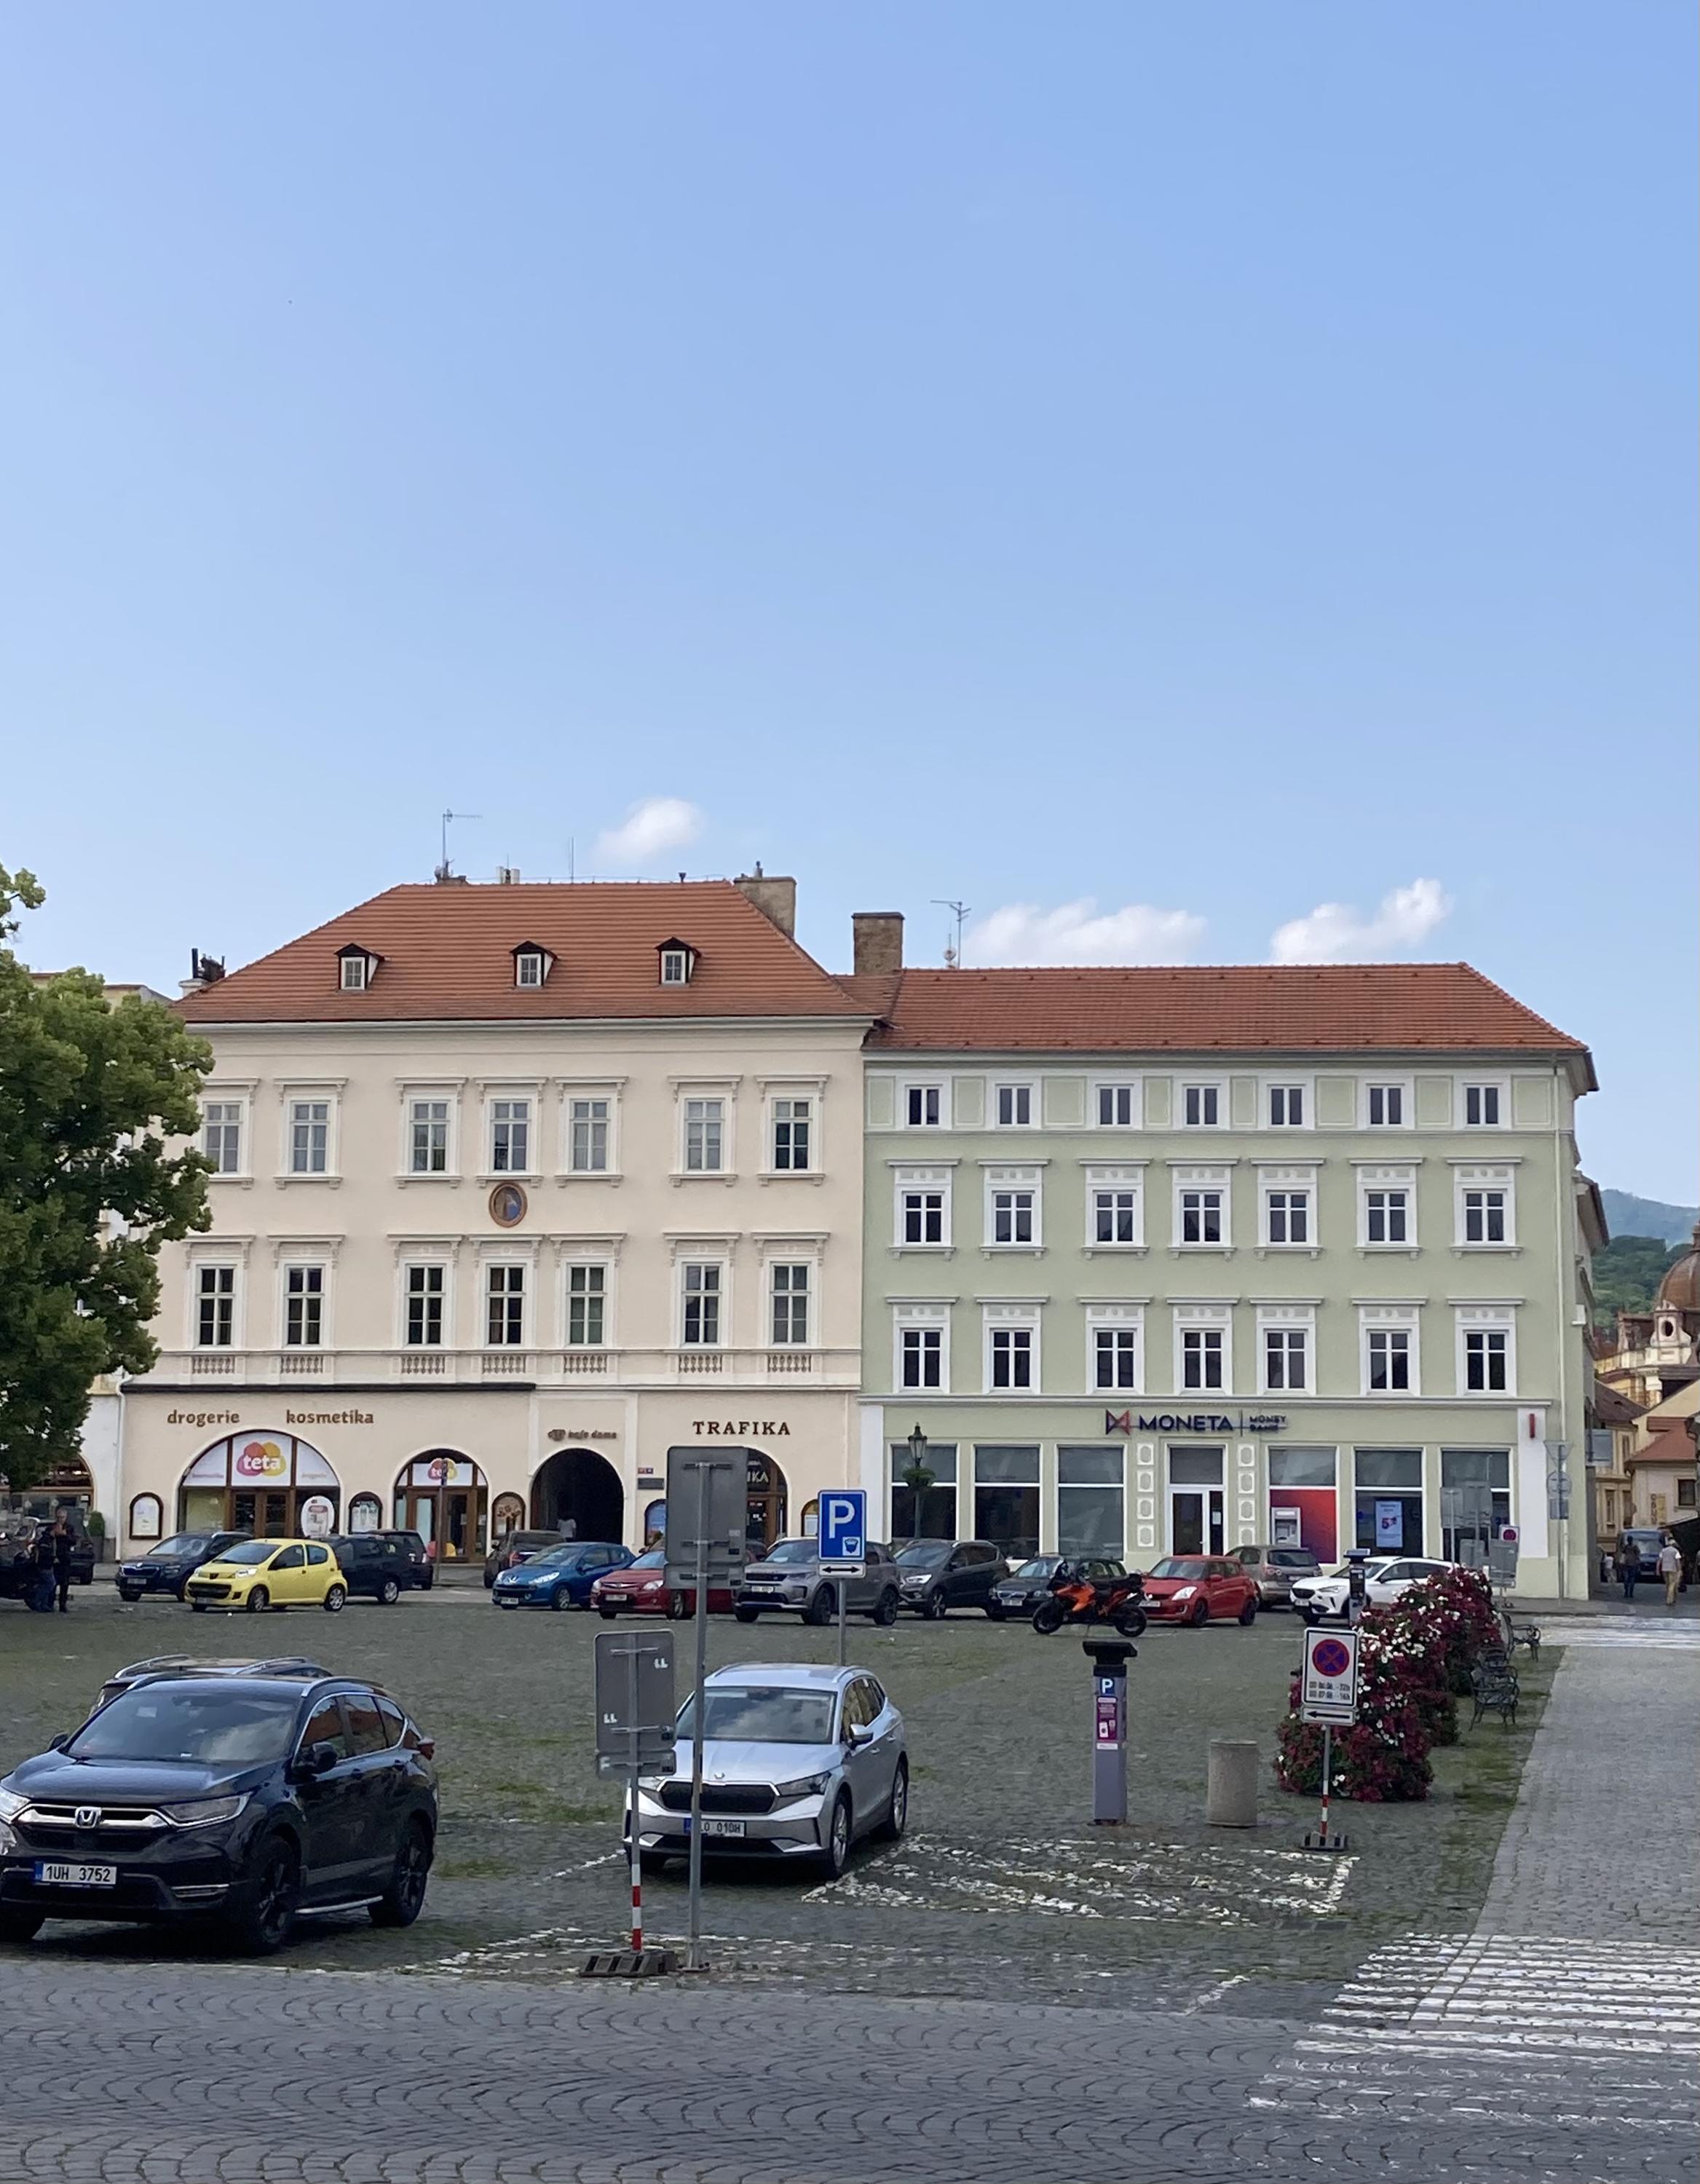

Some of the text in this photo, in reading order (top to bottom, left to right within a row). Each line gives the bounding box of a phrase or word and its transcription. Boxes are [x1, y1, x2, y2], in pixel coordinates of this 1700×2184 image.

[167, 1409, 374, 1428] drogerie kosmetika
[1139, 1415, 1233, 1431] MONETA
[692, 1421, 791, 1435] TRAFIKA
[242, 1455, 281, 1470] teta
[746, 1471, 769, 1482] IKA
[829, 1500, 855, 1539] P
[1101, 1678, 1114, 1694] P
[46, 1865, 111, 1882] 1UH 3752
